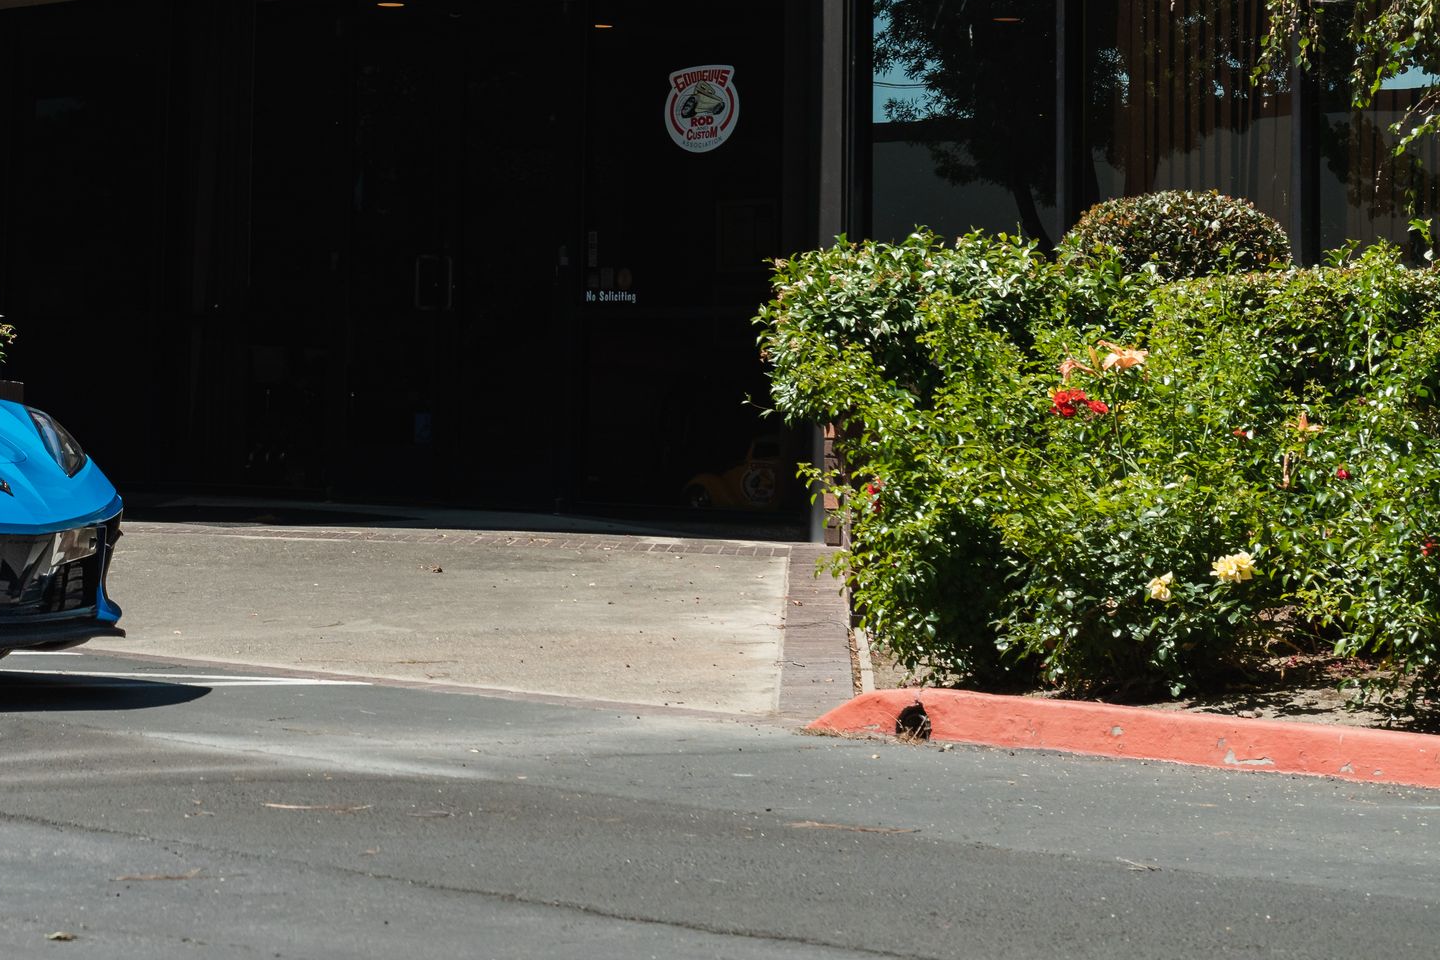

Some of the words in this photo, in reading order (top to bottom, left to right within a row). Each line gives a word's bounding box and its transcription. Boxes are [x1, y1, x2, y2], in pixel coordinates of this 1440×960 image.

[690, 116, 714, 127] ROD
[586, 291, 596, 302] No
[599, 290, 637, 304] Soliciting
